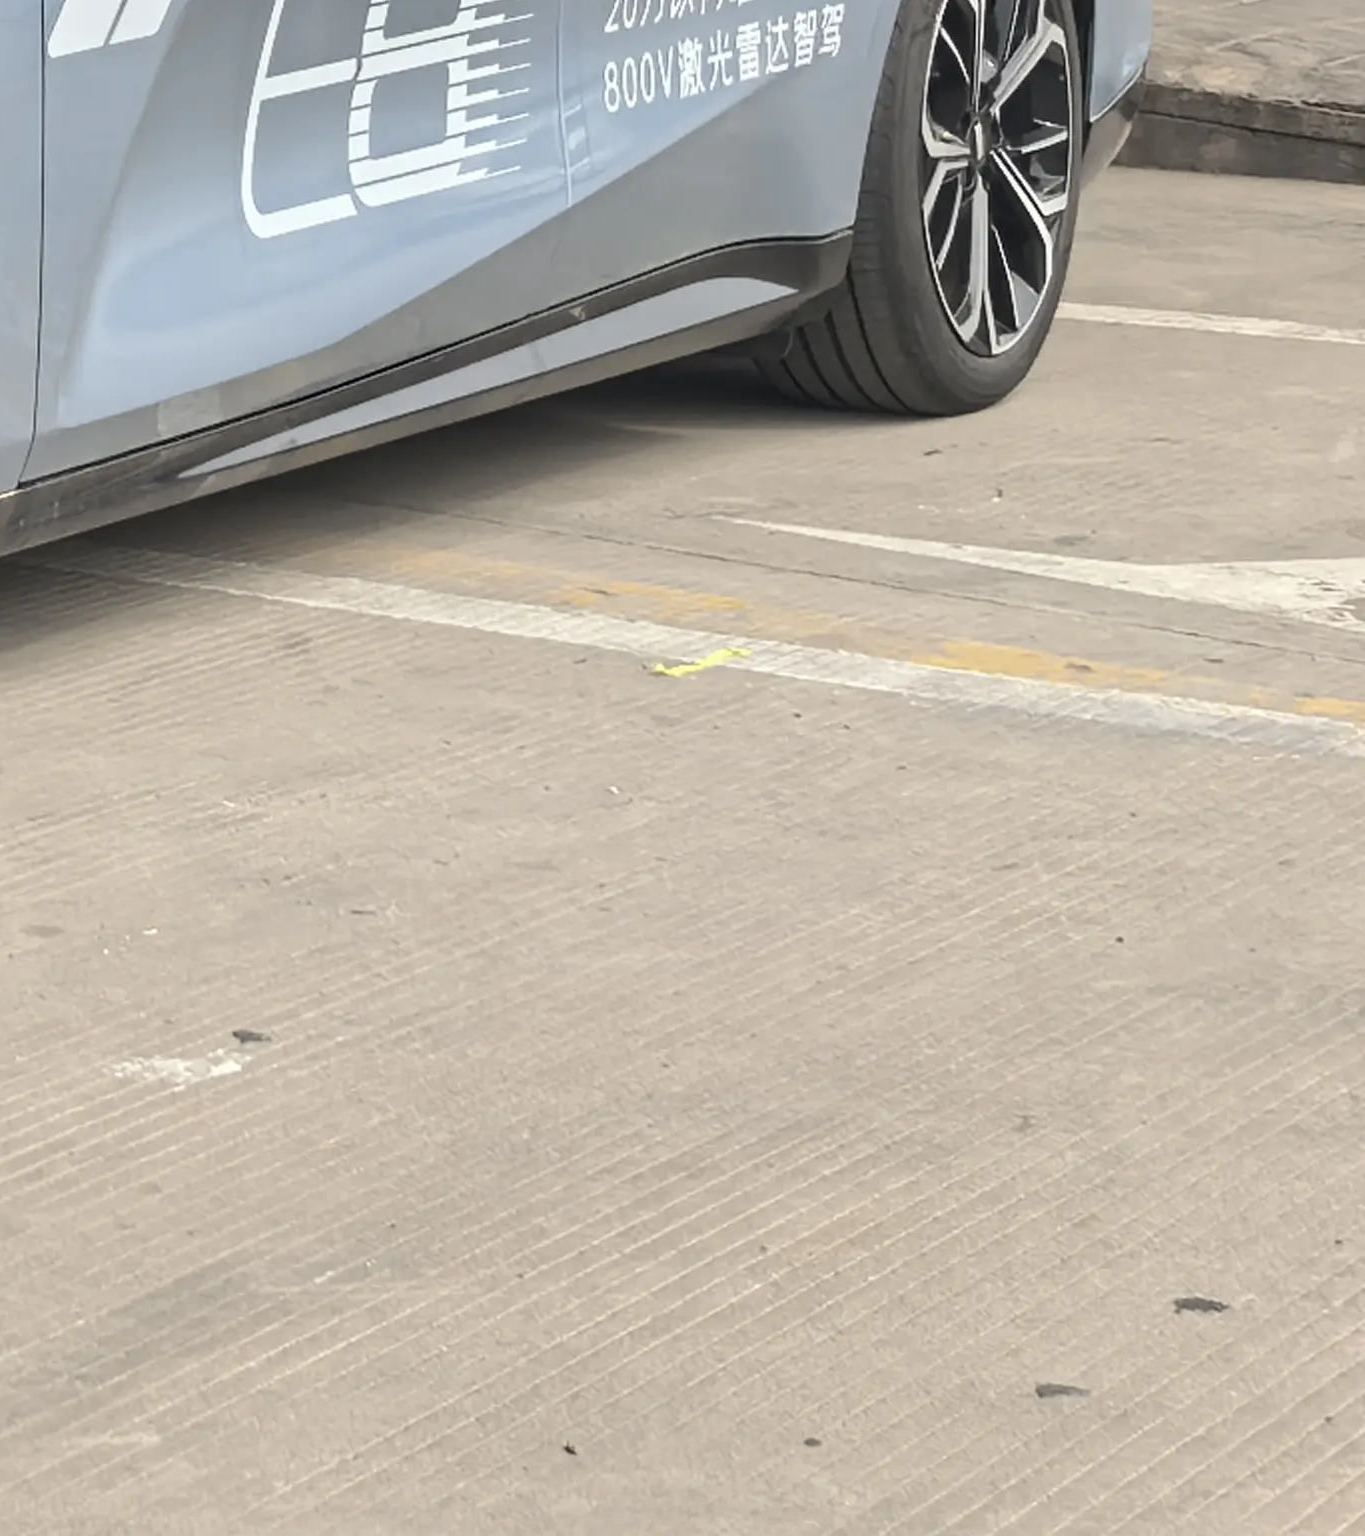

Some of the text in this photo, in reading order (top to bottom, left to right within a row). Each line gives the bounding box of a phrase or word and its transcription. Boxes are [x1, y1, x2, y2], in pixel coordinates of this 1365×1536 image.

[603, 3, 845, 113] 800V激光雷达智驾
